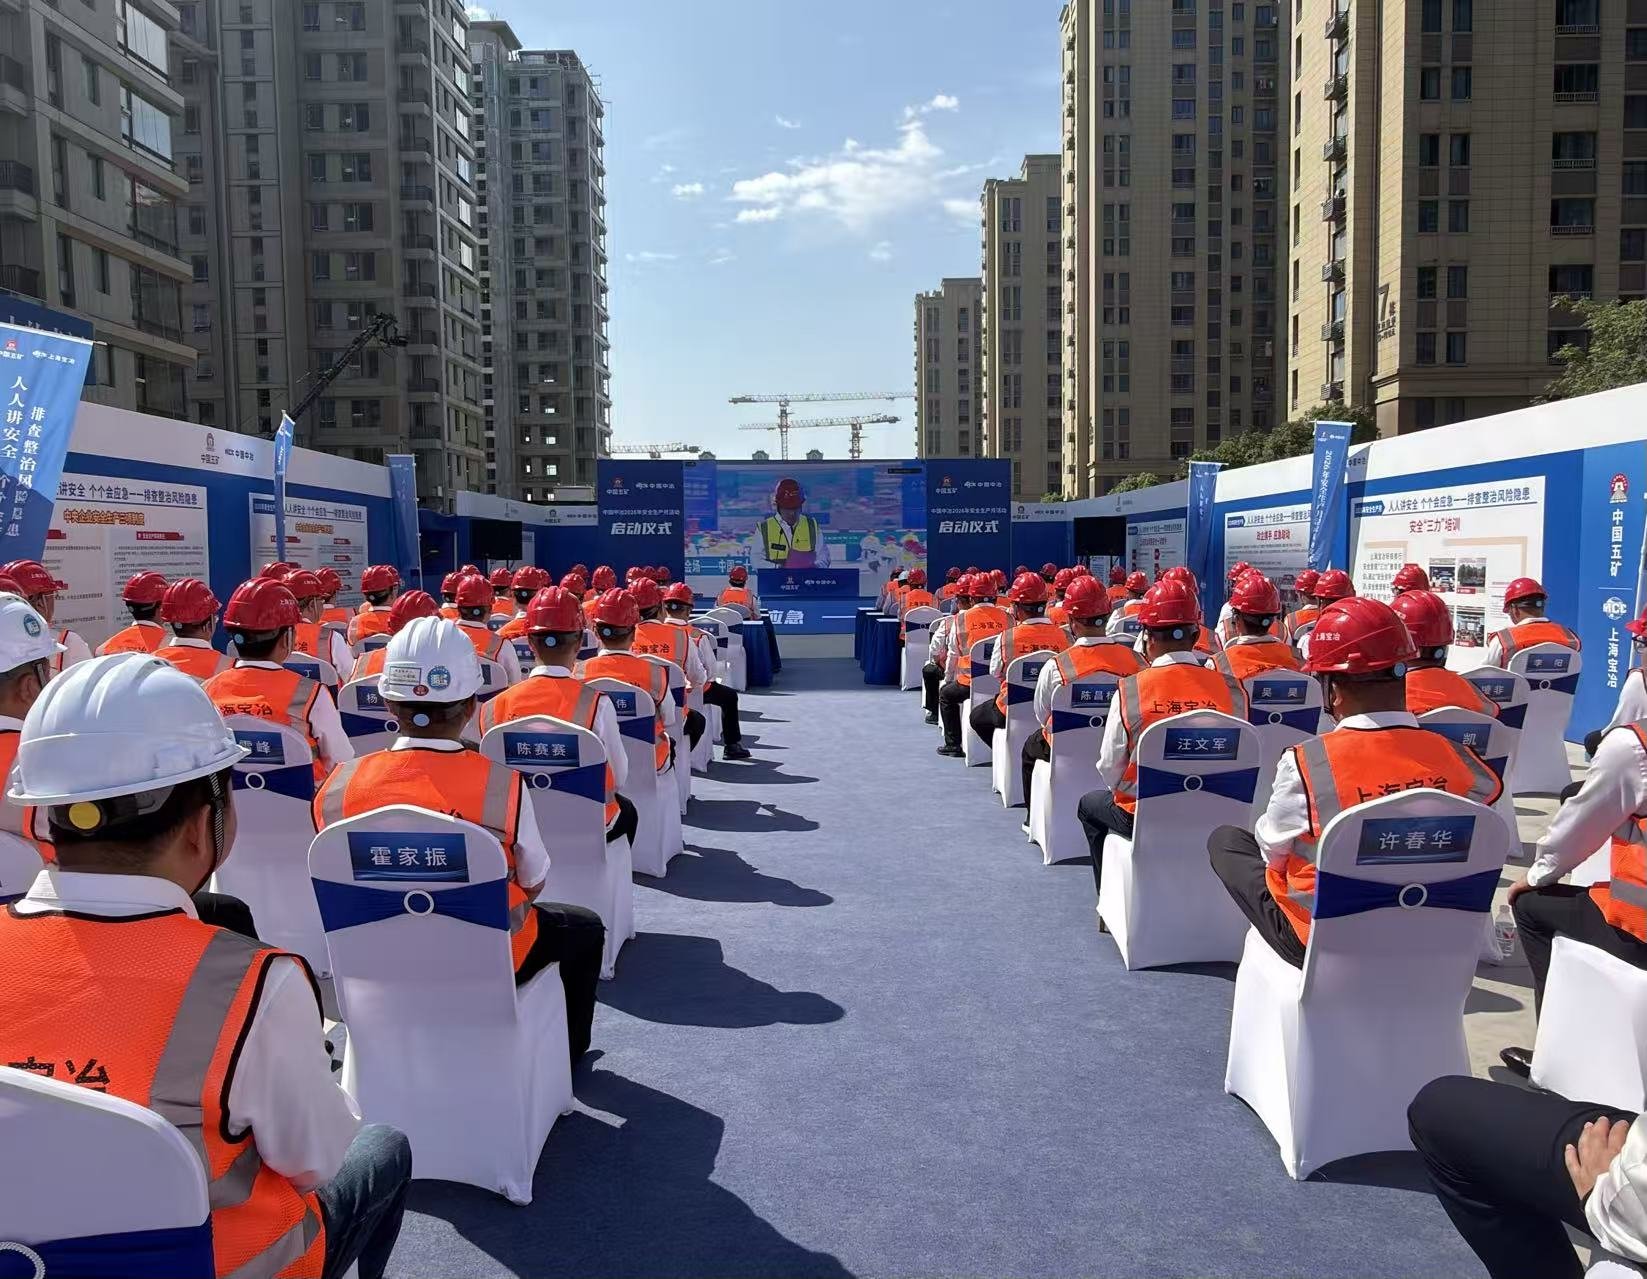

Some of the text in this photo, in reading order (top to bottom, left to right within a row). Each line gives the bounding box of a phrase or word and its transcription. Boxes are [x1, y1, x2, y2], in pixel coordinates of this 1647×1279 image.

[1, 376, 28, 459] 人人讲安全
[5, 406, 46, 537] 排查整治风险隐患
[56, 481, 86, 498] 讲安全
[1388, 487, 1531, 513] 人人讲安全 个个会应急——排查整治风险隐患
[611, 522, 672, 535] 启动仪式
[939, 520, 999, 533] 启动仪式
[1610, 508, 1624, 577] 中国五矿
[1314, 632, 1341, 641] 上海宝冶
[1607, 627, 1619, 688] 上海宝冶
[616, 698, 627, 709] 伟
[1177, 737, 1228, 752] 汪文军
[1462, 733, 1477, 746] 凯
[516, 741, 566, 757] 陈赛赛
[1379, 829, 1453, 850] 许春华
[369, 846, 448, 867] 霍家振
